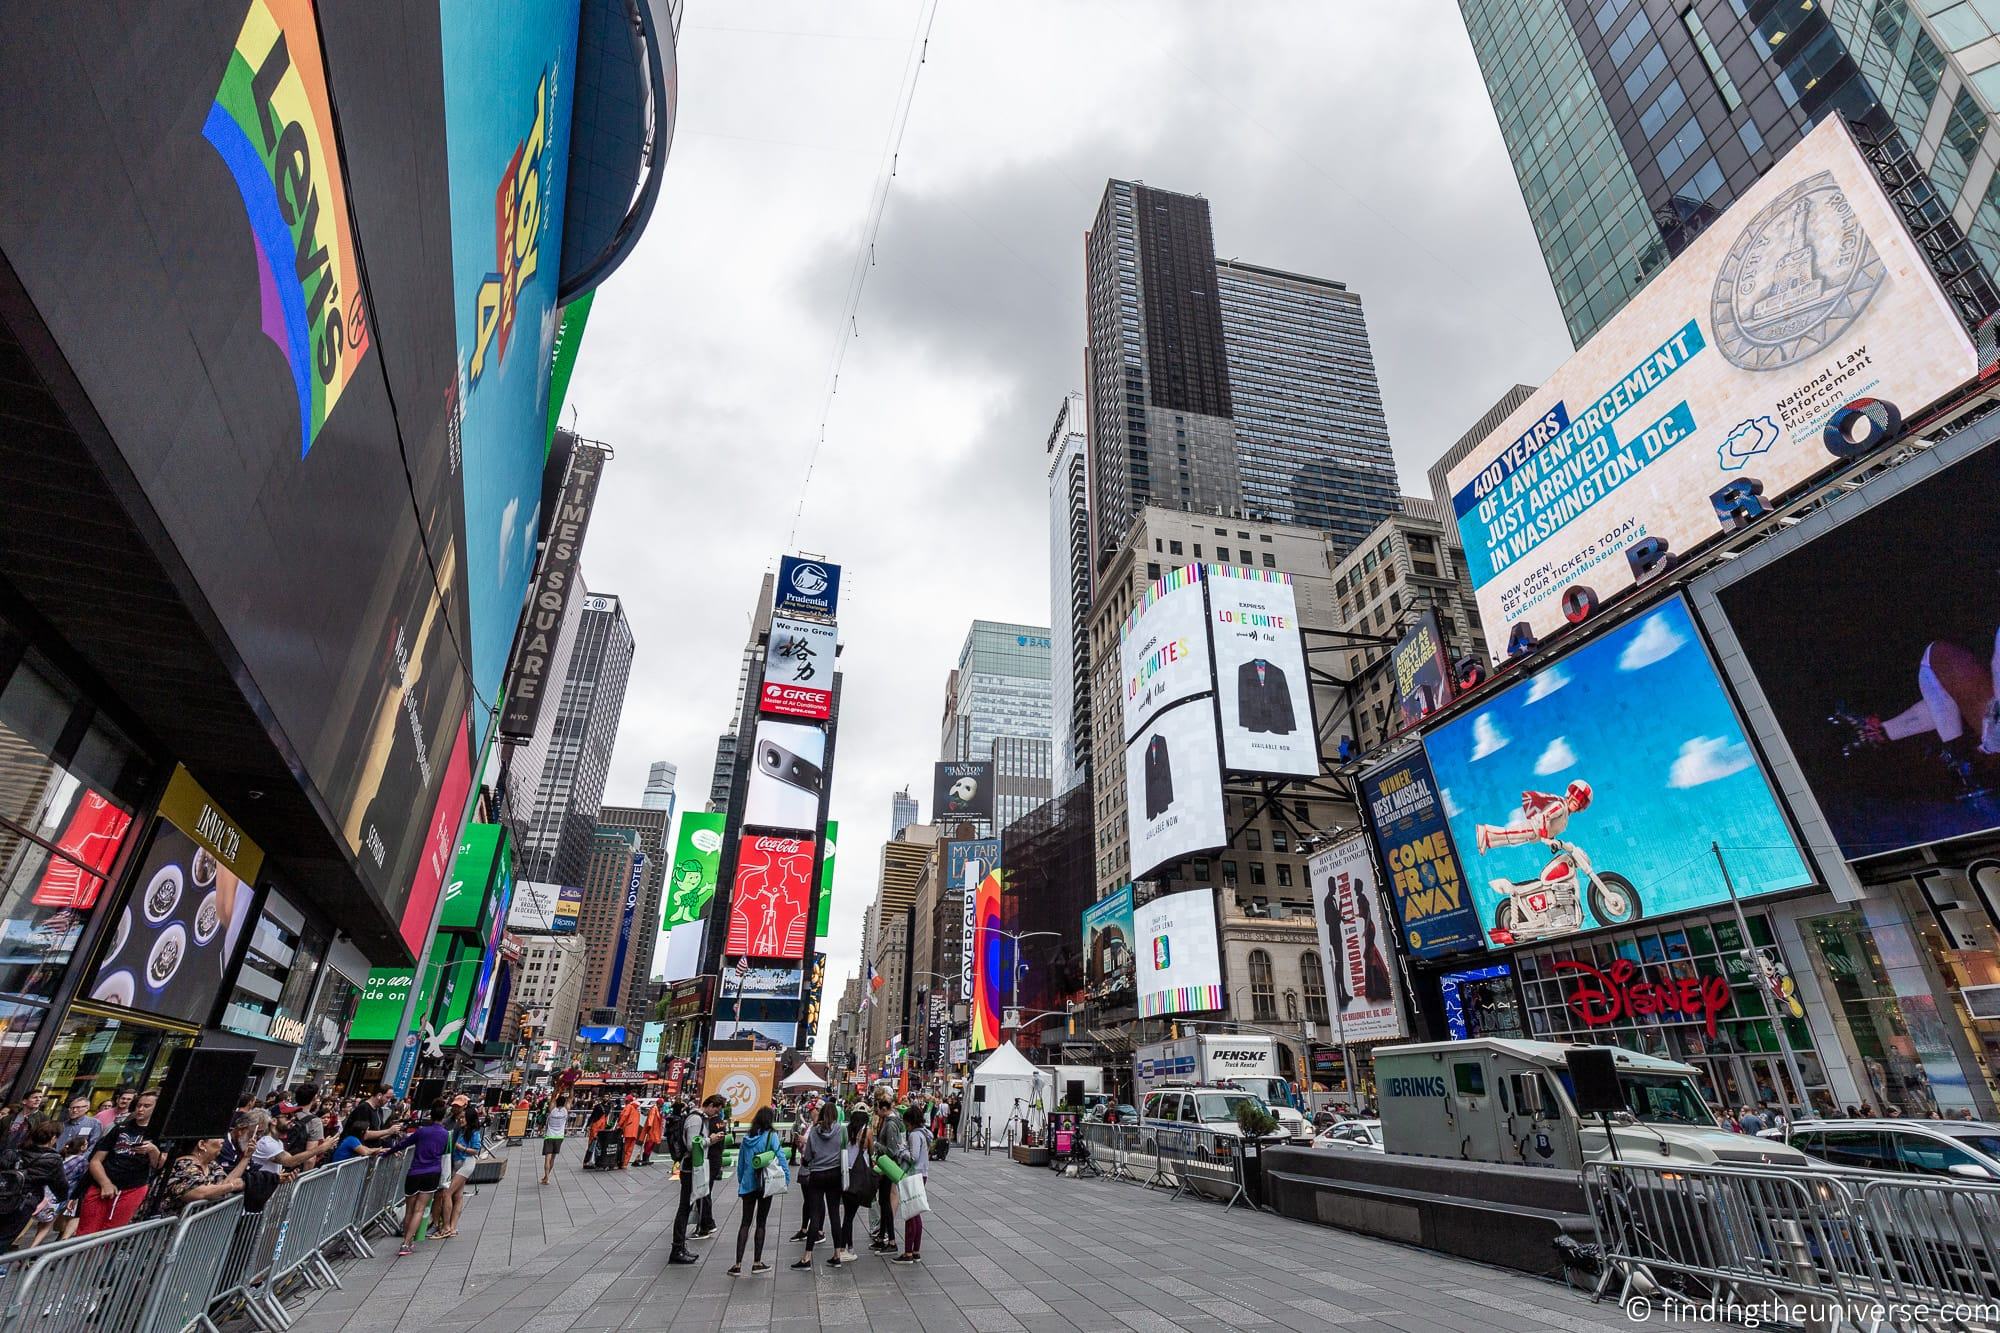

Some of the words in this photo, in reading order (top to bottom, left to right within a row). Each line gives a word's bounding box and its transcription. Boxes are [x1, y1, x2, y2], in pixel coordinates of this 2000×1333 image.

[514, 70, 547, 297] TOY
[502, 178, 516, 333] STORY
[470, 281, 502, 382] 4
[1776, 368, 1833, 412] National
[1837, 345, 1867, 370] Law
[1780, 355, 1873, 422] Enforcement
[1478, 490, 1502, 525] OF
[1502, 455, 1542, 503] LAW
[1540, 330, 1690, 476] ENFORCEMENT
[1785, 391, 1844, 432] Museum
[1798, 424, 1810, 436] the
[1810, 403, 1844, 427] Motorola
[1843, 379, 1880, 404] Solutions
[1473, 462, 1503, 499] 400
[1501, 411, 1560, 477] YEARS
[1486, 500, 1527, 549] JUST
[1529, 434, 1611, 514] ARRIVED
[1489, 541, 1510, 574] IN
[1508, 448, 1645, 560] WASHINGTON,
[1642, 416, 1687, 460] DC.
[555, 470, 595, 560] TIMES
[1501, 583, 1522, 603] NOW
[1523, 562, 1554, 587] OPEN!
[1503, 594, 1522, 613] GET
[1522, 577, 1550, 599] YOUR
[1551, 545, 1596, 579] TICKETS
[1598, 516, 1637, 547] TODAY
[1504, 524, 1648, 622] LawEnforcementMuseum.org
[786, 592, 828, 607] Prudential
[1239, 602, 1266, 611] EXPRESS
[516, 571, 565, 699] SQUARE
[776, 622, 791, 631] We
[793, 625, 809, 633] are
[811, 628, 834, 637] Gree
[1219, 610, 1248, 626] LOVE
[1252, 613, 1293, 631] UNITES
[1263, 631, 1275, 642] Out
[1396, 637, 1418, 668] ABOUT
[1417, 626, 1429, 642] AS
[1397, 647, 1421, 677] GUILTY
[1419, 639, 1431, 655] AS
[1399, 644, 1438, 687] PLEASURES
[1128, 661, 1146, 701] LOVE
[1146, 636, 1190, 681] UNITES
[510, 713, 529, 721] NYC
[764, 697, 782, 706] Master
[796, 701, 827, 711] Conditioning
[775, 704, 817, 715] www.gree.com
[783, 689, 827, 704] GREE
[1372, 795, 1394, 818] BEST
[1392, 778, 1431, 810] MUSICAL
[1378, 768, 1413, 797] WINNER!
[1166, 815, 1179, 829] NOW
[1377, 817, 1386, 828] ALL
[1385, 810, 1401, 824] ACROSS
[1414, 795, 1435, 812] AMERICA
[195, 804, 241, 863] INVICTA
[754, 836, 801, 854] Coca-Cola
[952, 845, 972, 858] MY
[973, 844, 999, 857] FAIR
[1388, 830, 1450, 873] COME
[1313, 865, 1329, 877] GOOD
[1329, 860, 1344, 871] TIME
[1344, 850, 1370, 865] TONIGHT
[1318, 854, 1334, 867] HAVE
[1333, 852, 1339, 860] A
[1339, 842, 1360, 857] REALLY
[1393, 853, 1459, 897] FROM
[625, 860, 644, 911] NOVOTEL
[1337, 871, 1356, 926] PRETTY
[1404, 880, 1461, 922] AWAY
[554, 917, 576, 927] FROZEN
[963, 882, 978, 999] COVERGIRL
[1346, 934, 1367, 998] WOMAN
[388, 991, 405, 1001] on
[1213, 1050, 1268, 1062] PENSKE
[1391, 1076, 1446, 1098] BRINKS
[1538, 1135, 1548, 1147] B
